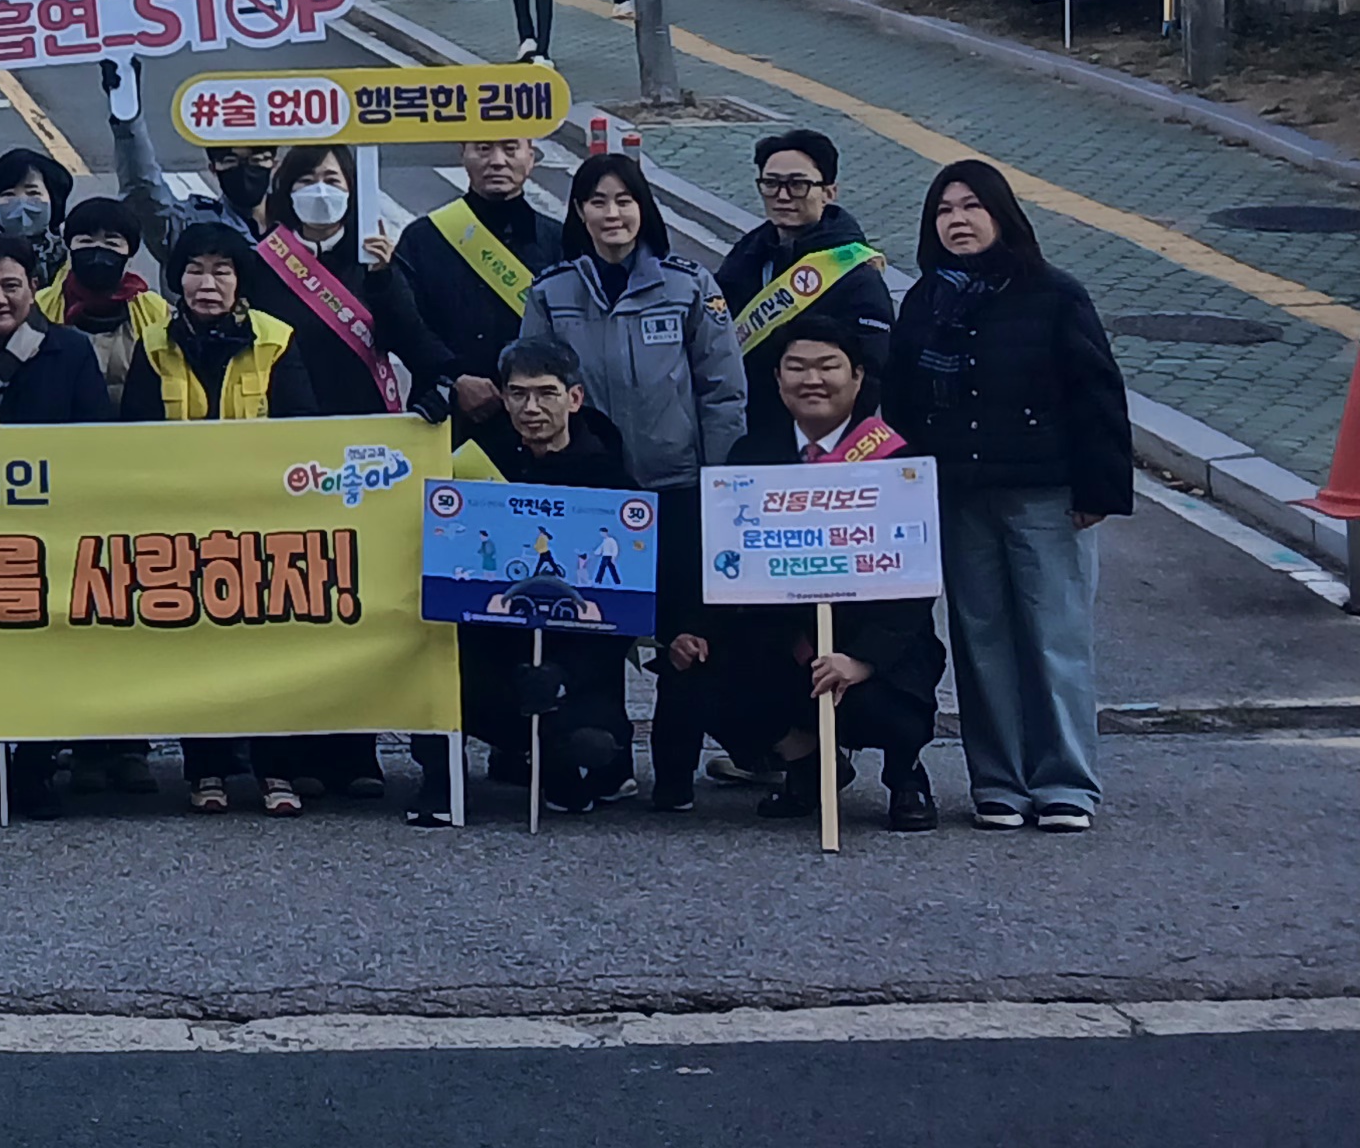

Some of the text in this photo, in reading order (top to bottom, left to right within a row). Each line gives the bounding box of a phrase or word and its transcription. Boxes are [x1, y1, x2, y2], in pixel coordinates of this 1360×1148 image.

[190, 81, 553, 130] #술 없이 행복한 김해
[287, 458, 409, 505] 아이좋아
[438, 494, 455, 509] 50
[762, 487, 880, 513] 전동킥보드
[627, 507, 645, 521] 30
[742, 526, 875, 550] 운전면허 필수!
[854, 553, 901, 574] 필수!
[69, 528, 363, 627] 사랑하자!
